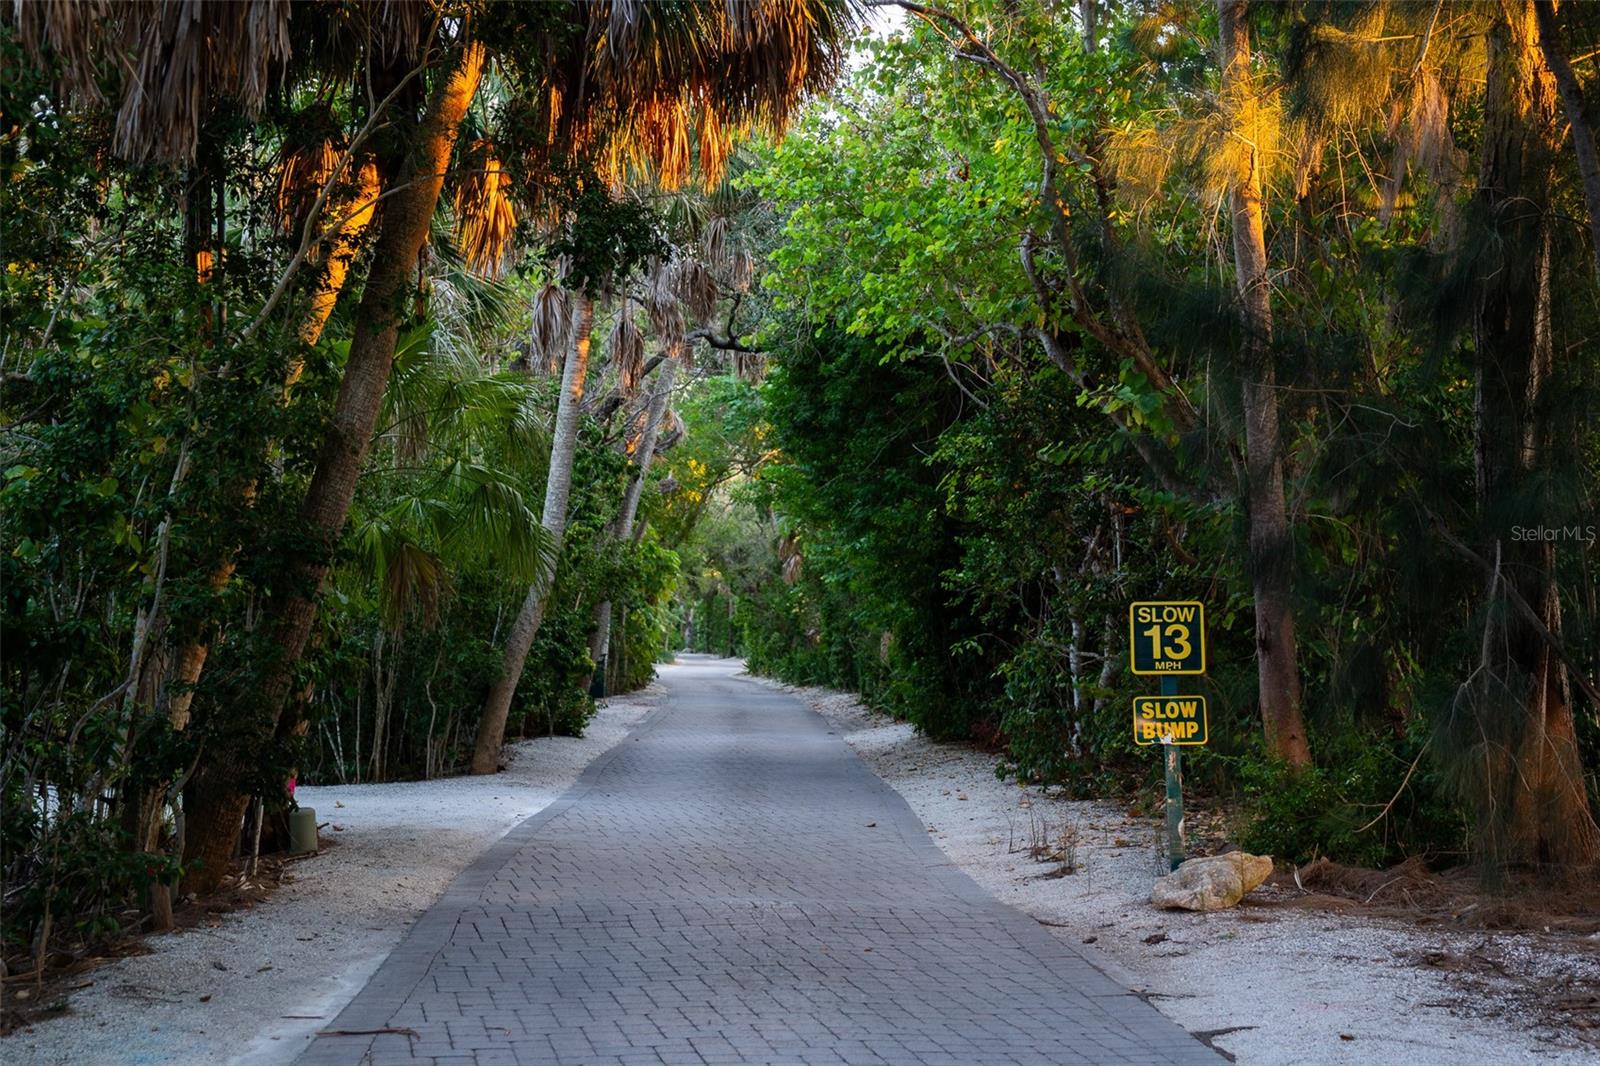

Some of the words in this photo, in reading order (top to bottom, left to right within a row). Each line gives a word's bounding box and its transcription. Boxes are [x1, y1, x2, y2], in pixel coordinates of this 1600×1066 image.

[1138, 607, 1196, 623] SLOW
[1143, 624, 1192, 660] 13
[1155, 661, 1182, 670] MPH
[1141, 701, 1197, 719] SLOW
[1142, 722, 1199, 739] BUMP
